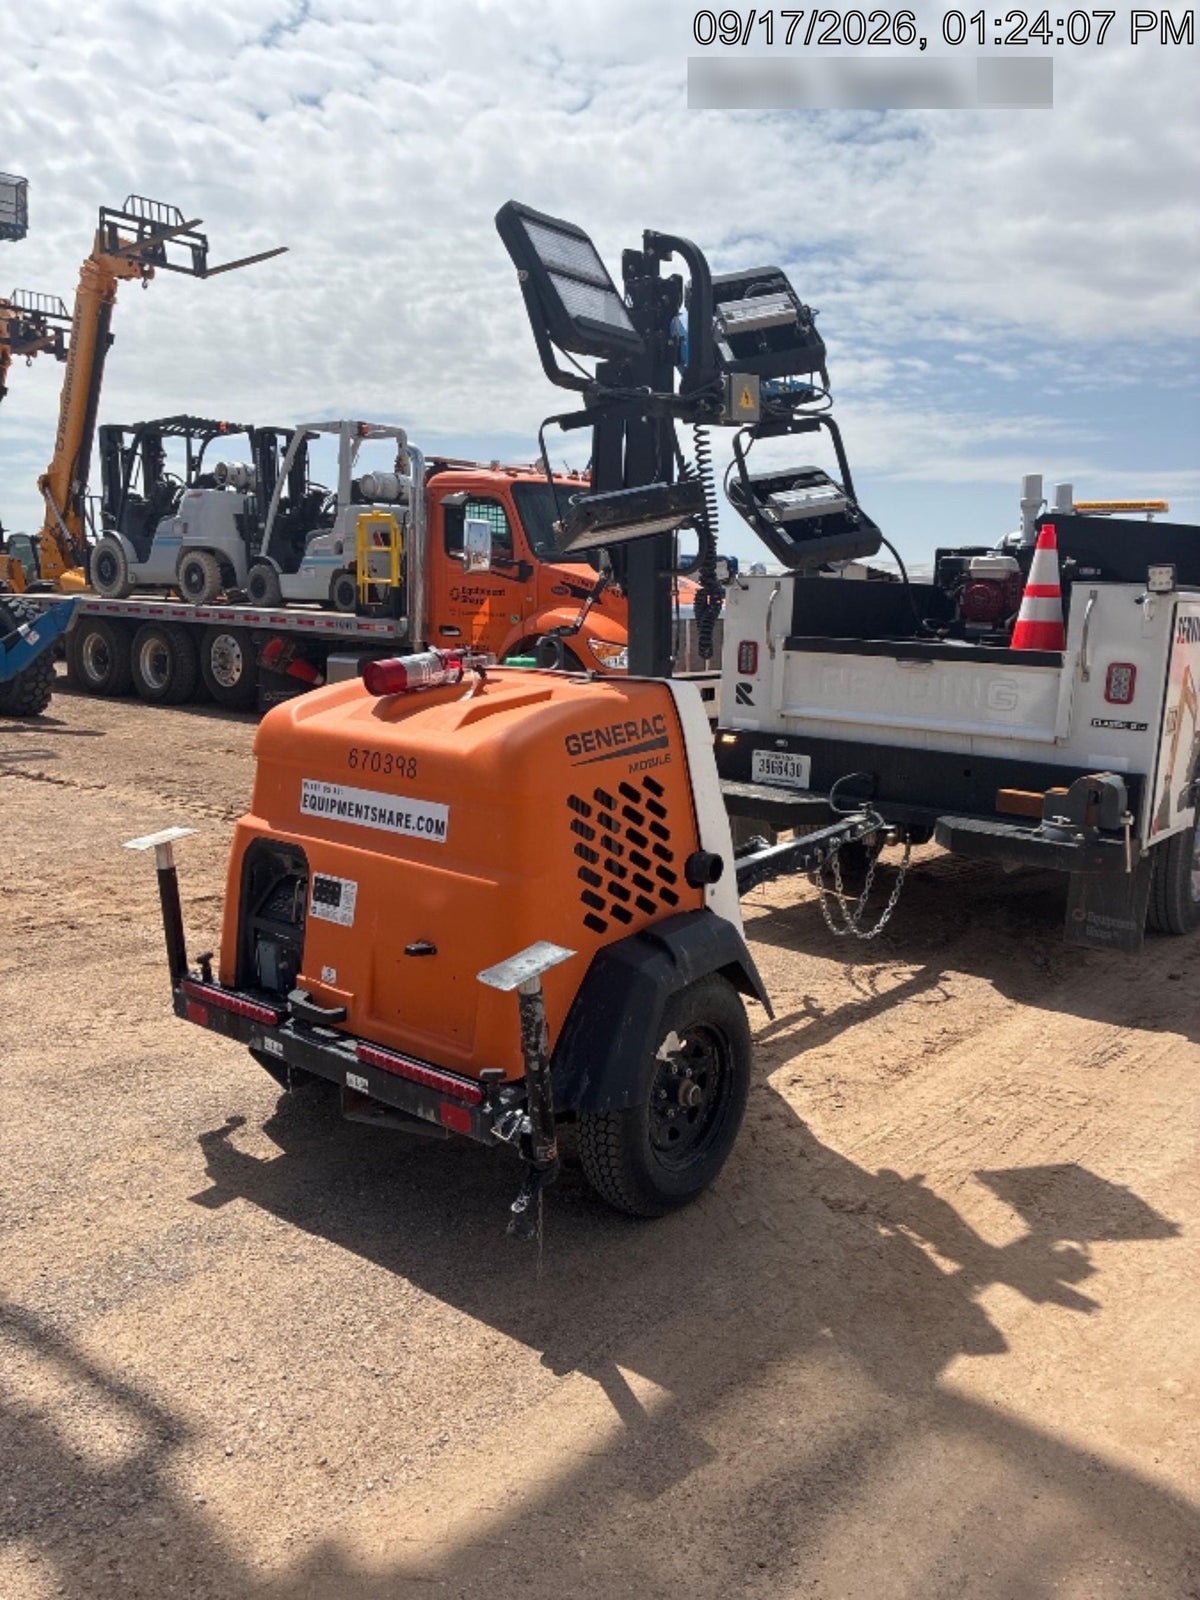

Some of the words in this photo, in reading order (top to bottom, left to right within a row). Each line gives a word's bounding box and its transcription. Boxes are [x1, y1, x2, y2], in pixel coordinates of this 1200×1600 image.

[565, 714, 667, 756] GENERAC
[348, 748, 417, 779] 670398
[628, 754, 671, 774] MOBILE
[302, 793, 446, 836] EQUIPMENTSHARE.COM
